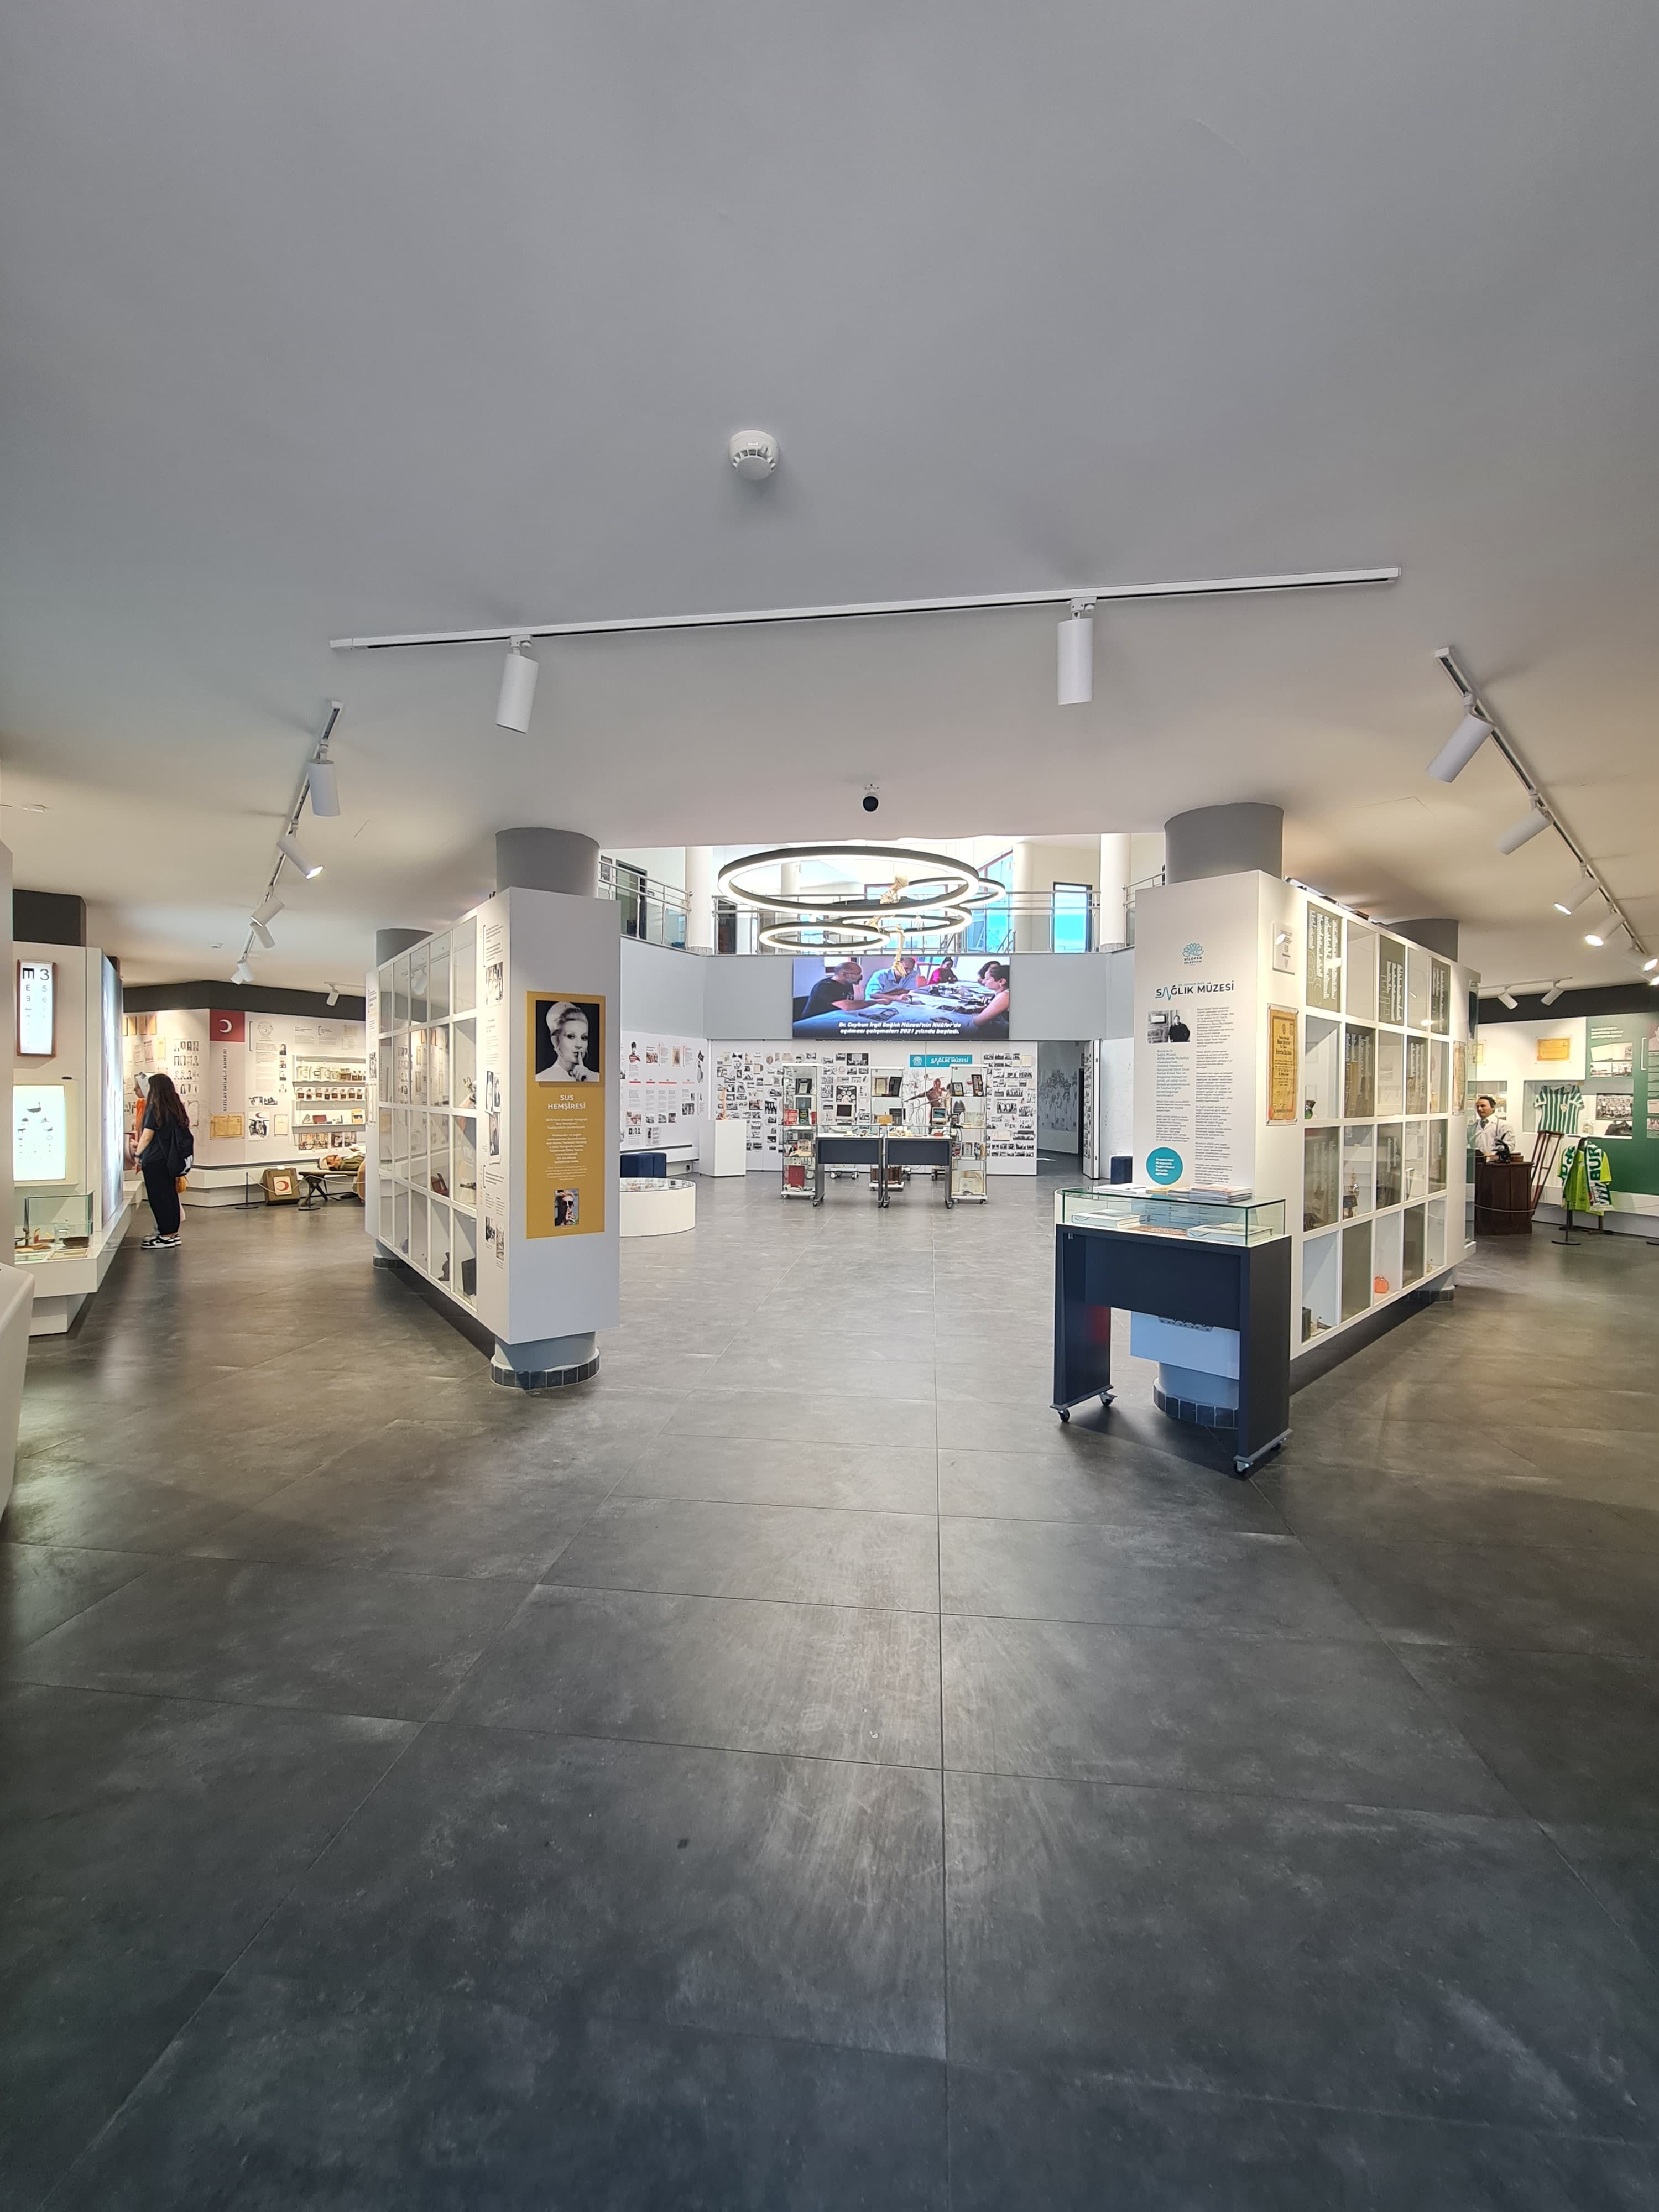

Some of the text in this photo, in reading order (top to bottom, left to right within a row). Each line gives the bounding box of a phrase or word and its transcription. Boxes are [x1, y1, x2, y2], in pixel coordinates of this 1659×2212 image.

[40, 968, 49, 980] 3
[1197, 980, 1234, 993] MÜZESİ
[547, 1102, 586, 1110] HEMŞİRESİ
